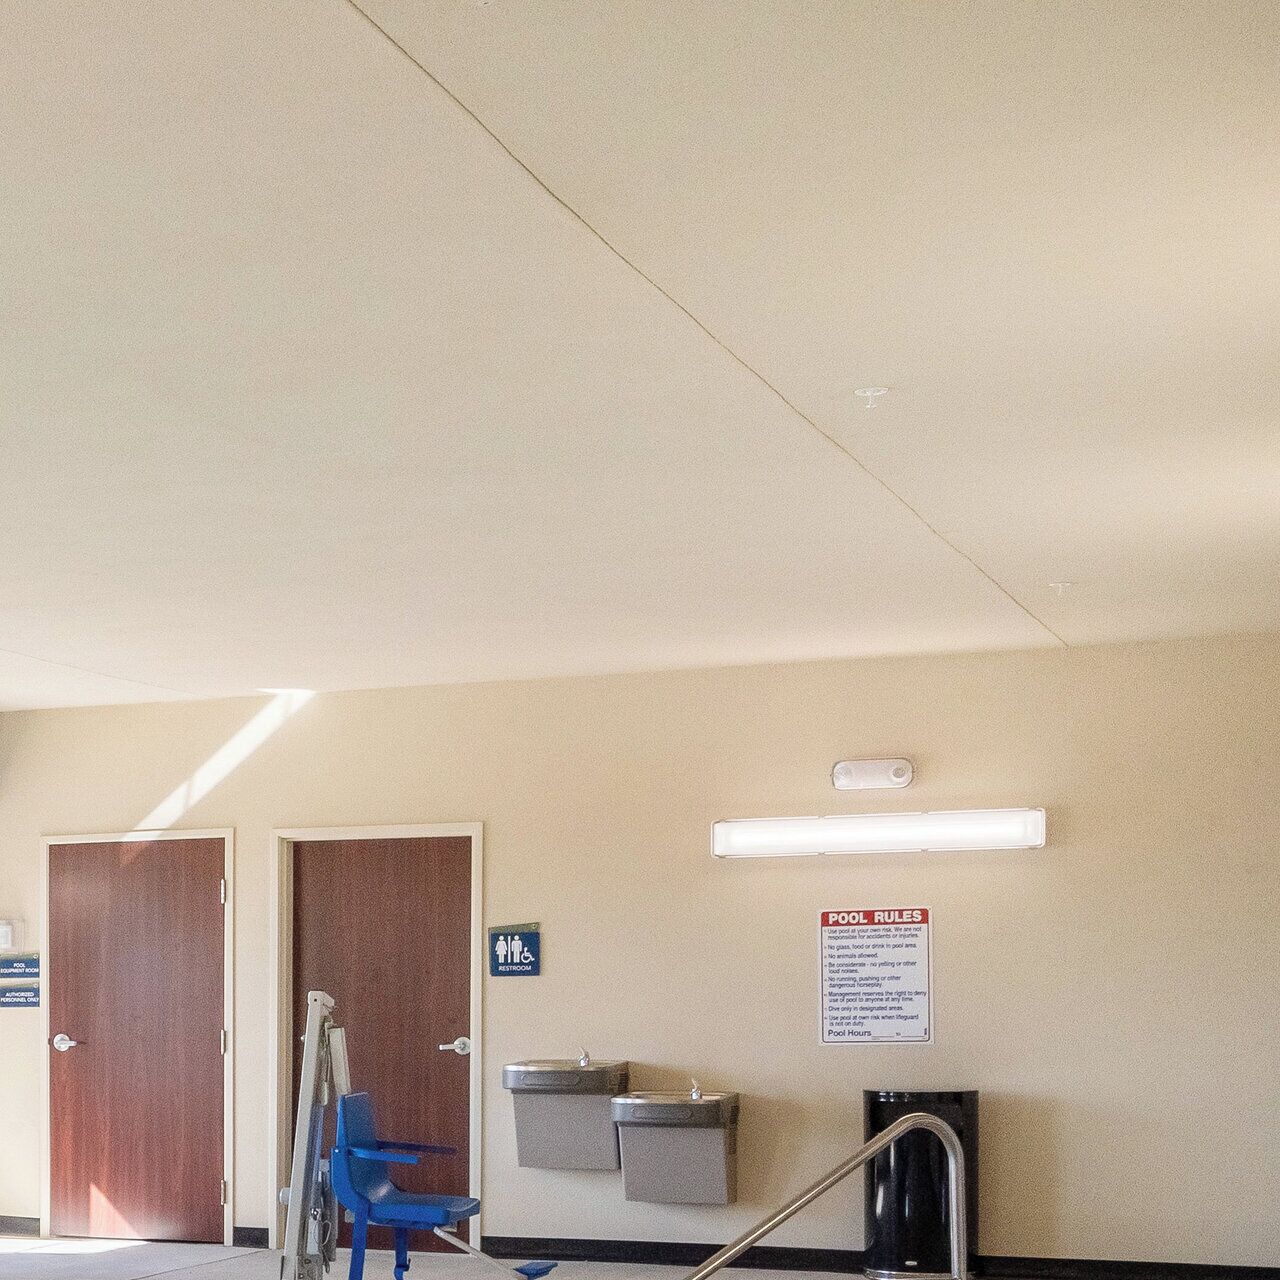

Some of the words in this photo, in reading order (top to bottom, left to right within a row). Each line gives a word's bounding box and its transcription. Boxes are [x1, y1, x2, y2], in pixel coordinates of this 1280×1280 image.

[828, 912, 868, 925] POOL
[874, 910, 922, 923] RULES
[828, 991, 860, 999] Management
[828, 1029, 846, 1037] Pool
[848, 1029, 872, 1037] Hours
